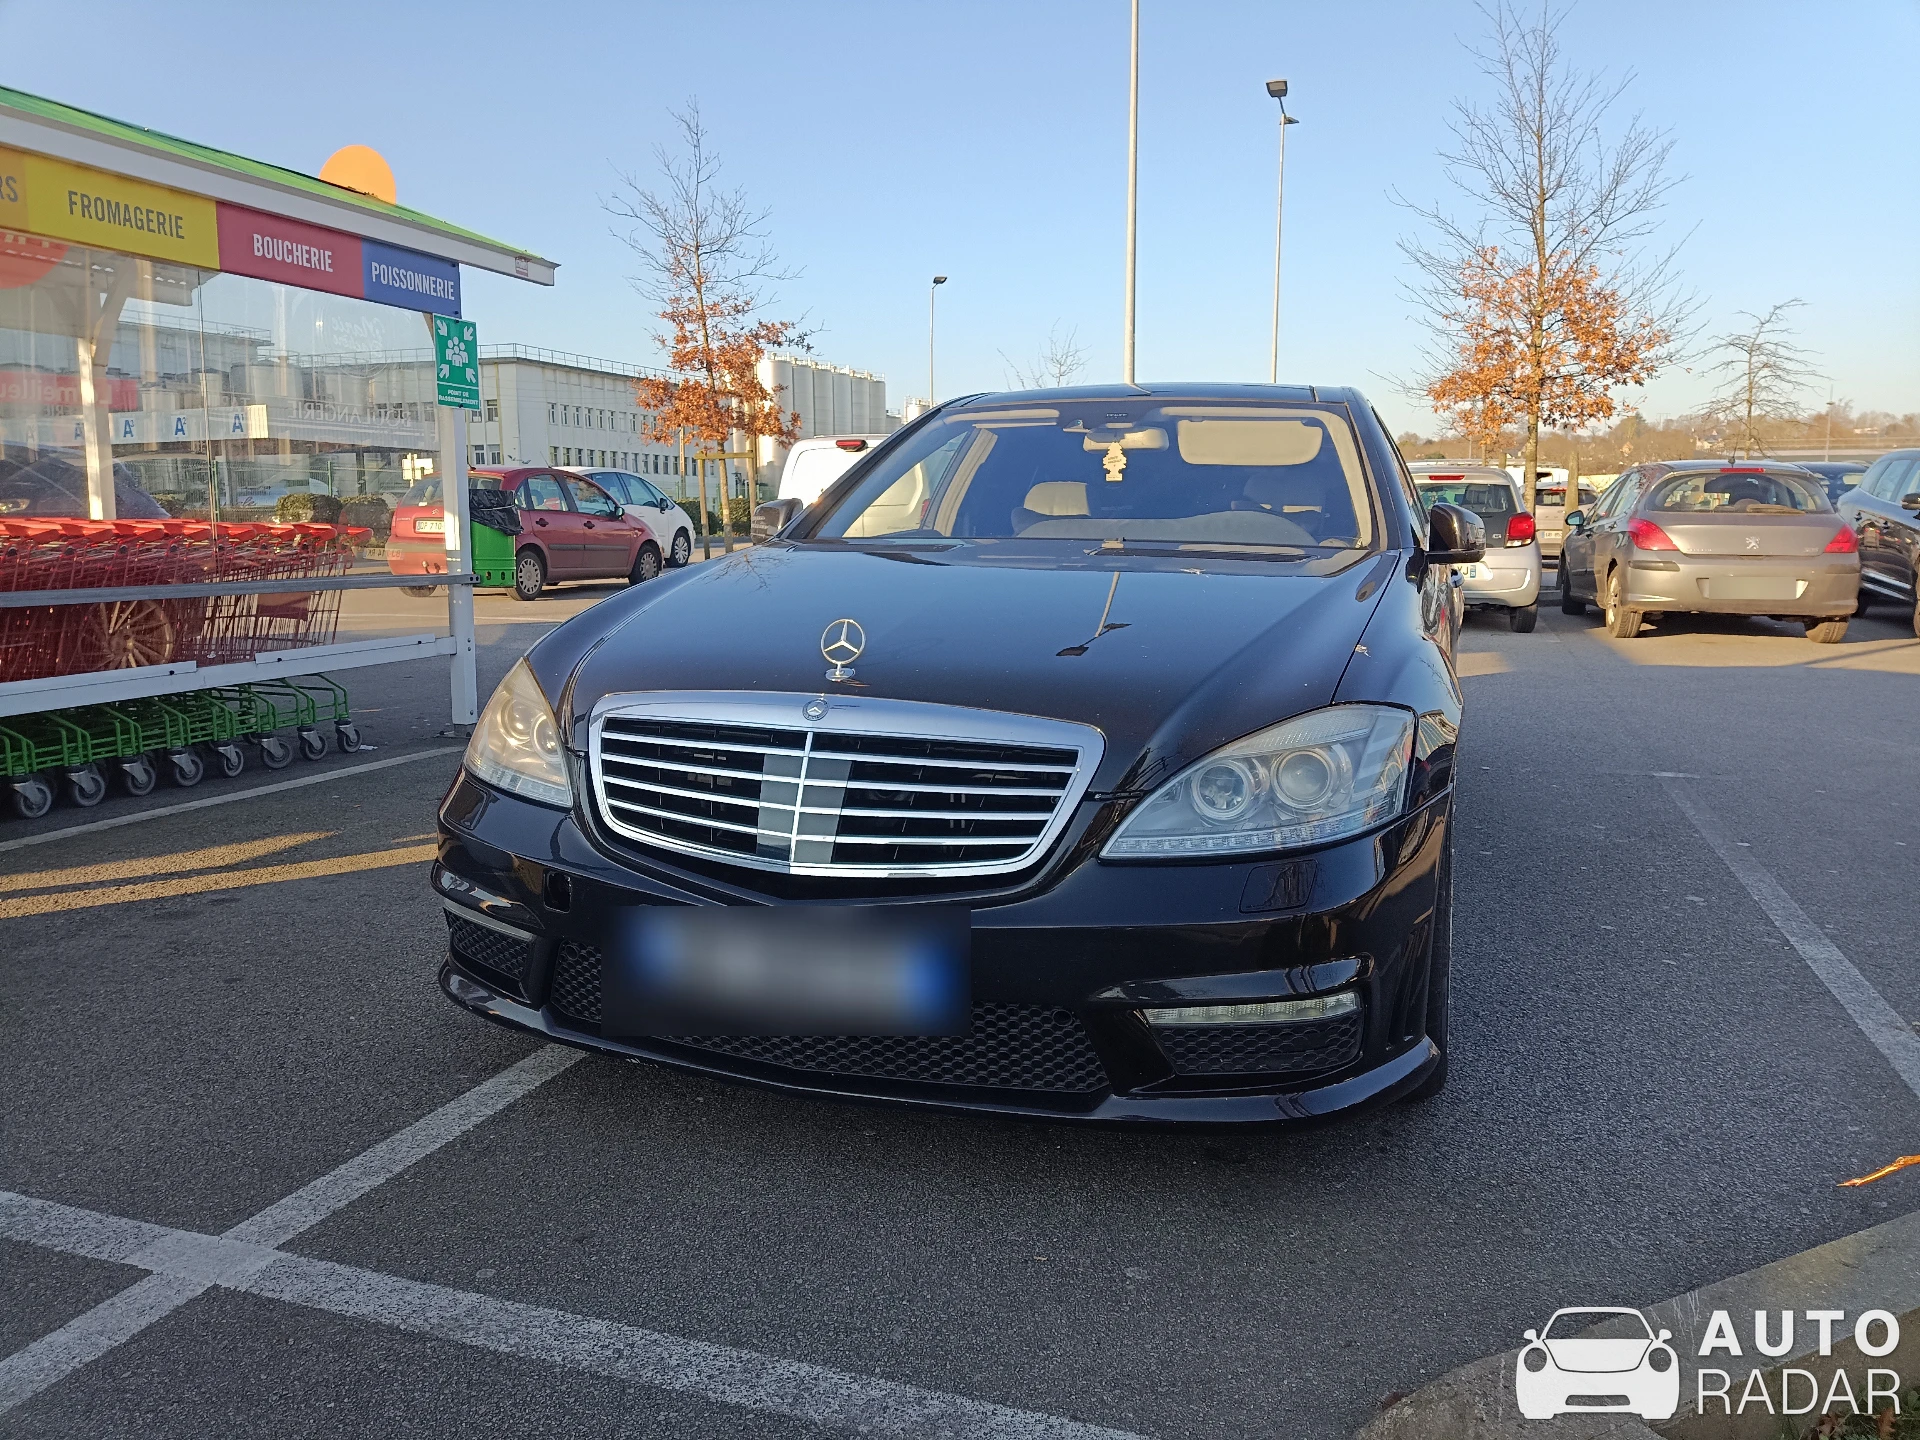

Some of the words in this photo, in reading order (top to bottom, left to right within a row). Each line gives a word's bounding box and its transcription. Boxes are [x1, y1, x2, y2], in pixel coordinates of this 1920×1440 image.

[68, 190, 185, 240] FROMAGERIE
[253, 233, 333, 273] BOUCHERIE
[371, 261, 455, 301] POISSONNERIE
[438, 395, 478, 405] RASSEMBLEMENT
[447, 389, 462, 397] POINT
